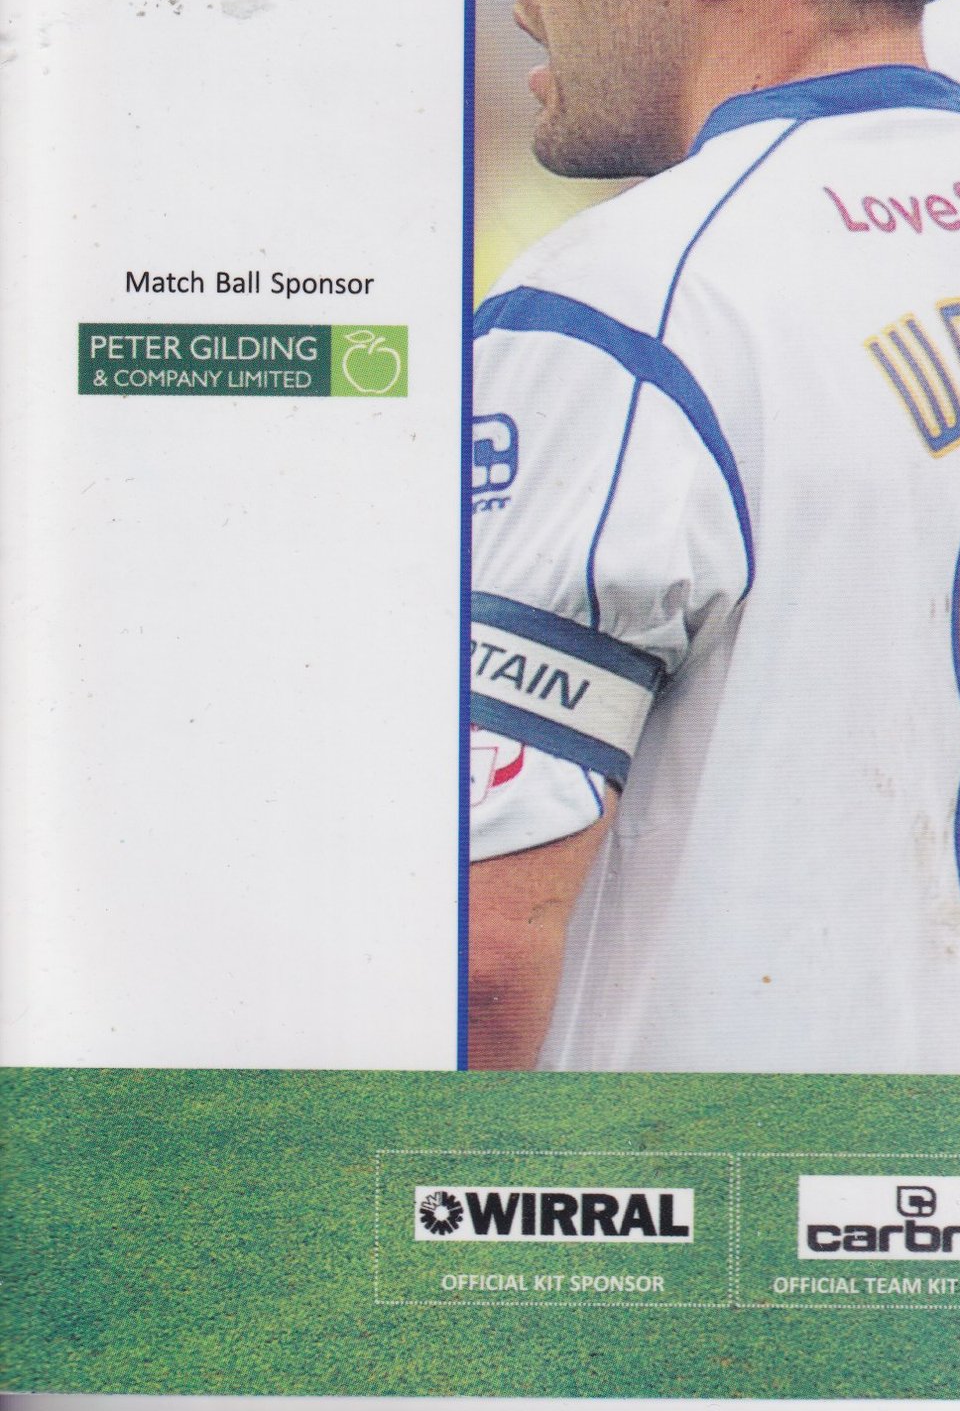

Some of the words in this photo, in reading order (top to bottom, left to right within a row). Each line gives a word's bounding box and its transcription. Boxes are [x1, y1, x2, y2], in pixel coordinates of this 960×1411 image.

[125, 270, 205, 294] Match
[215, 271, 260, 294] Ball
[270, 272, 375, 300] Sponsor
[90, 335, 182, 360] PETER
[189, 336, 318, 361] GILDING
[92, 369, 108, 387] &
[114, 369, 222, 388] COMPANY
[228, 370, 312, 389] LIMITED
[471, 637, 591, 712] TAIN
[465, 1191, 690, 1237] WIRRAL
[441, 1273, 529, 1292] OFFICIAL
[534, 1274, 566, 1292] KIT
[569, 1274, 665, 1293] SPONSOR
[773, 1276, 862, 1295] OFFICIAL
[865, 1277, 922, 1295] TEAM
[928, 1277, 960, 1295] KIT
